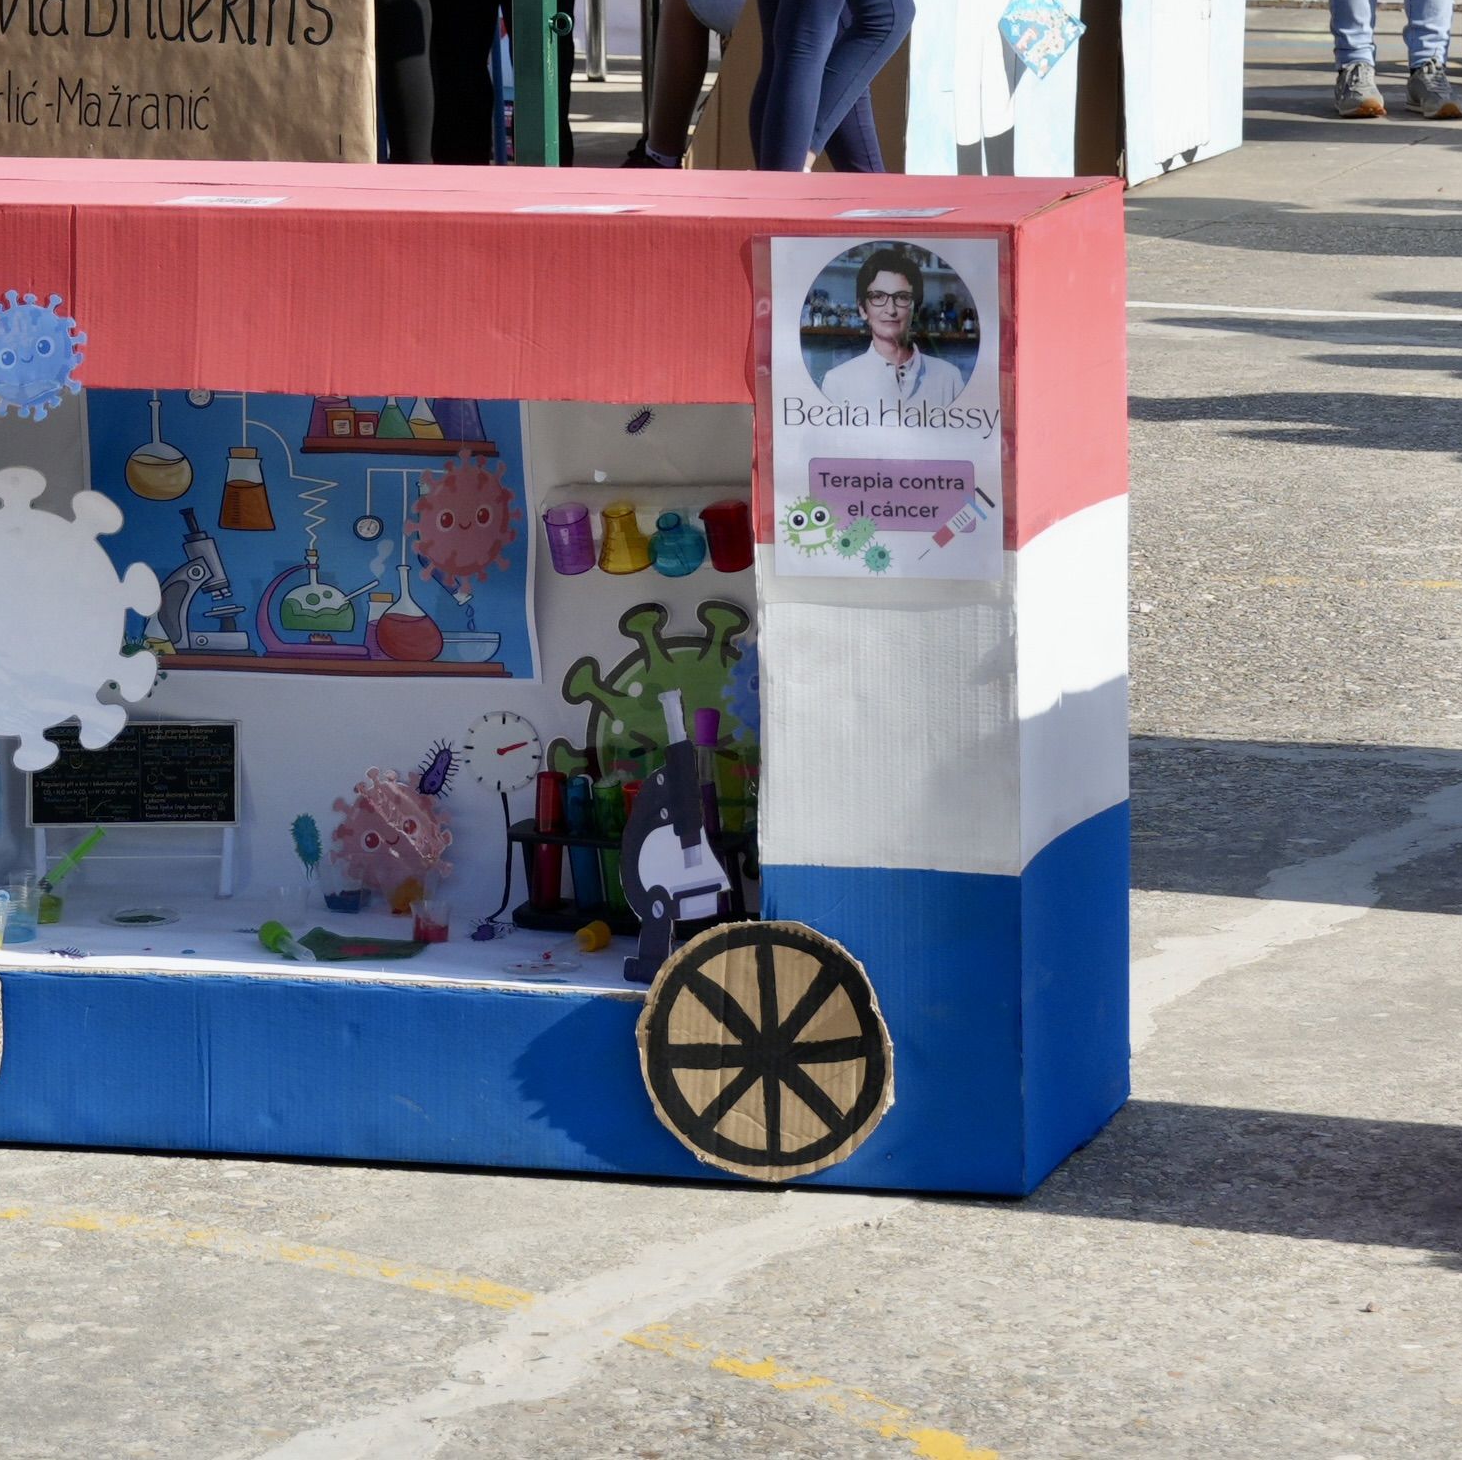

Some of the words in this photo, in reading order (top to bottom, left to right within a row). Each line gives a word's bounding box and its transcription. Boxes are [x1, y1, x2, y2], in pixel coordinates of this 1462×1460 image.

[879, 398, 1001, 440] Halassy
[818, 471, 894, 494] Terapia
[899, 474, 965, 491] contra
[847, 500, 864, 518] el
[871, 500, 940, 519] cáncer
